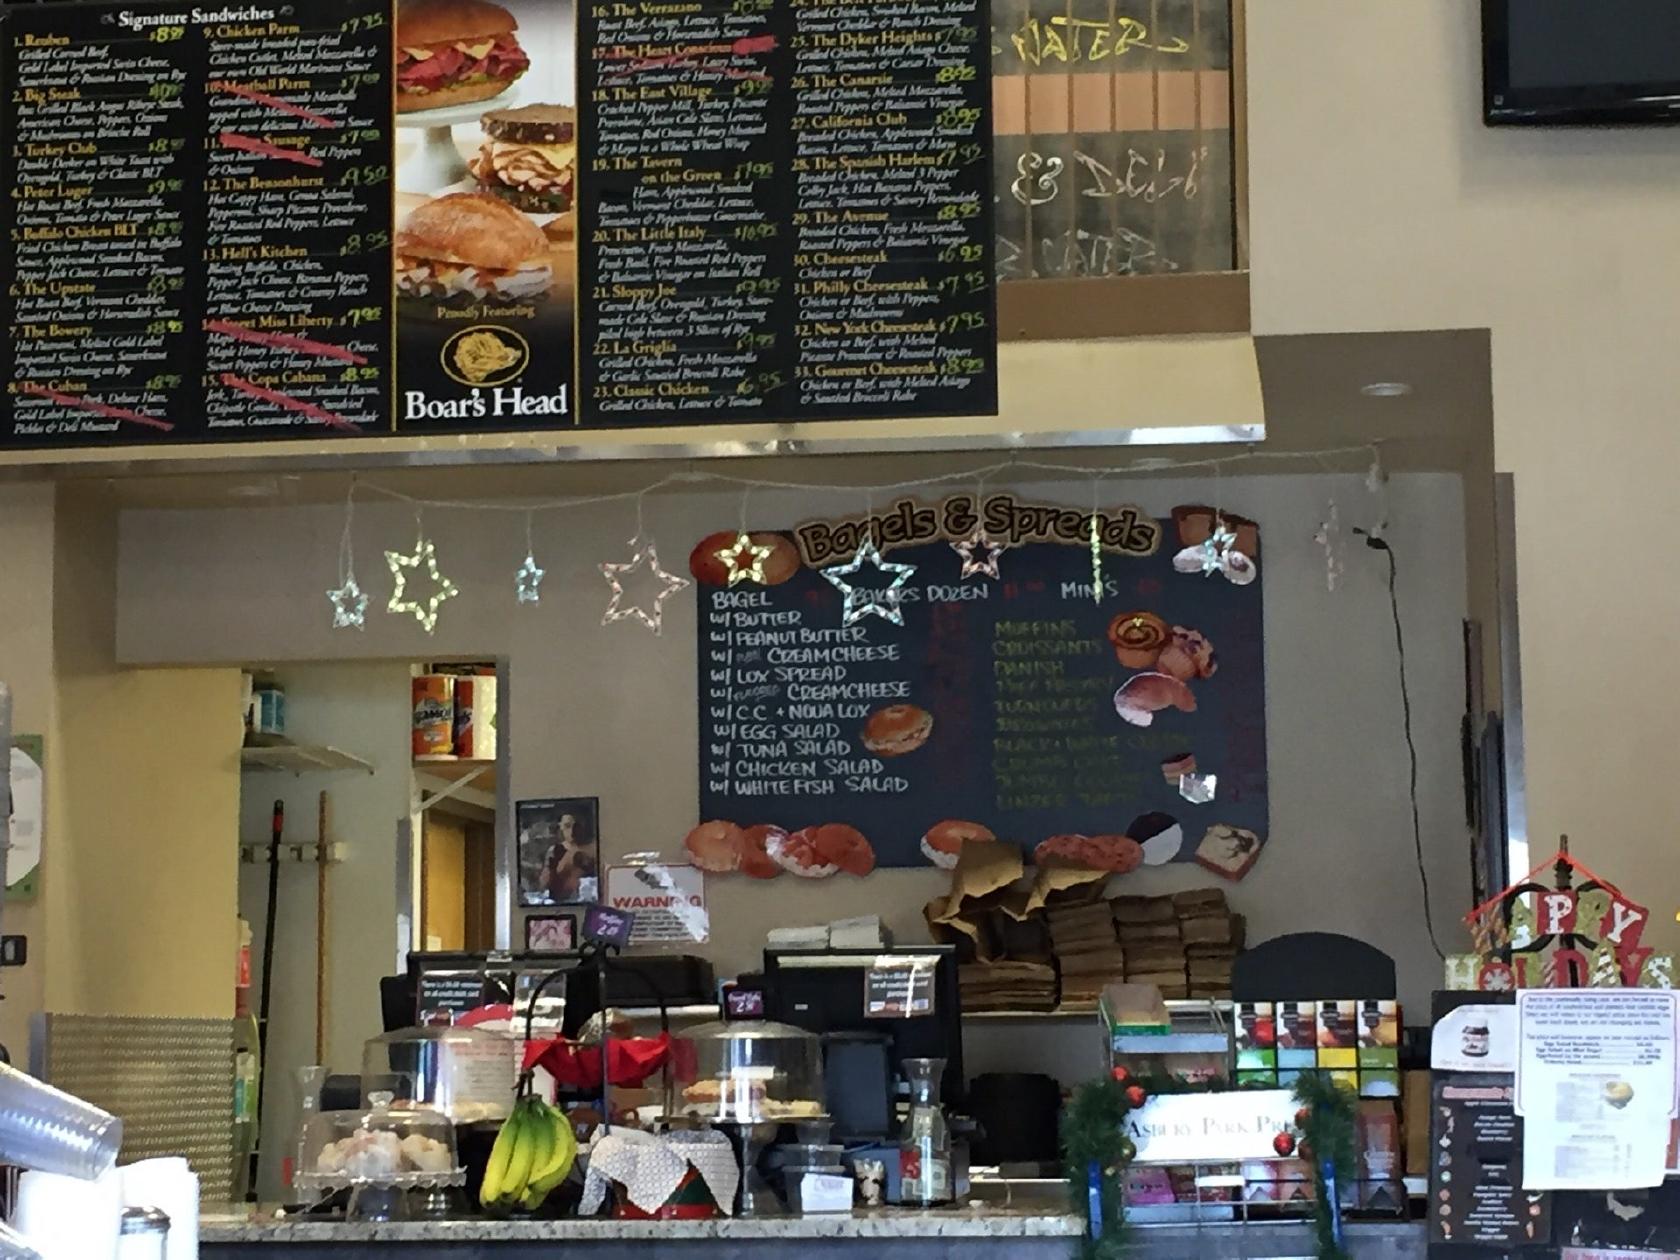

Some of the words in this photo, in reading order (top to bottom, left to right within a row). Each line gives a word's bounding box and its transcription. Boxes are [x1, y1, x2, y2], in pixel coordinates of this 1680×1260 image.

[612, 4, 636, 16] The
[118, 11, 188, 31] Signature
[191, 6, 274, 23] Sandwiches
[203, 28, 214, 39] 9.
[217, 25, 265, 38] Chicken
[269, 23, 300, 35] Parm
[25, 33, 70, 46] Reuben
[814, 34, 836, 46] The
[840, 32, 878, 48] Dyker
[882, 31, 932, 45] Heights
[279, 78, 311, 91] Parm
[813, 75, 836, 87] The
[839, 73, 893, 86] Canarsie
[25, 88, 46, 105] Big
[612, 88, 637, 99] The
[640, 86, 666, 98] East
[669, 84, 712, 101] Village
[812, 115, 873, 129] California
[876, 113, 907, 124] Club
[26, 143, 64, 156] Turkey
[68, 142, 97, 154] Club
[614, 157, 637, 170] The
[641, 156, 682, 167] Tavern
[815, 157, 837, 170] The
[840, 155, 886, 171] Spanish
[889, 153, 935, 166] Harlem
[223, 177, 247, 190] The
[250, 176, 324, 189] Bensonhurst
[642, 175, 657, 184] on
[660, 171, 680, 182] the
[683, 169, 722, 181] Green
[11, 188, 22, 198] 4.
[24, 186, 54, 197] Peter
[58, 184, 93, 199] Luger
[815, 211, 838, 223] The
[843, 210, 889, 222] Avenue
[24, 228, 63, 240] Buffalo
[66, 226, 112, 238] Chicken
[115, 223, 138, 236] BLT
[615, 229, 638, 241] The
[641, 227, 675, 239] Little
[678, 226, 706, 241] Italy
[261, 246, 308, 257] Kitchen
[814, 250, 888, 264] Cheesesteak
[24, 283, 47, 295] The
[51, 281, 96, 297] Upstate
[593, 286, 610, 298] 21.
[612, 284, 655, 300] Sloppy
[658, 283, 677, 299] Joe
[814, 281, 849, 298] Philly
[853, 277, 929, 292] Cheesesteak
[260, 315, 287, 327] Miss
[290, 314, 333, 328] Liberty
[815, 323, 840, 334] New
[842, 321, 869, 333] York
[871, 319, 936, 333] Cheesesteak
[23, 325, 47, 337] The
[50, 325, 92, 337] Bowery
[614, 342, 629, 353] La
[633, 340, 677, 356] Griglia
[282, 369, 326, 382] Cabana
[815, 364, 867, 376] Gourmet
[869, 361, 936, 375] Cheesesteak
[614, 384, 654, 396] Classic
[658, 383, 710, 394] Chicken
[405, 388, 486, 419] Boar's
[493, 382, 568, 416] Head
[800, 501, 936, 562] Bagels
[945, 497, 978, 536] &
[984, 496, 1156, 553] Spreads
[712, 591, 773, 610] BAGEL
[926, 583, 989, 603] DOZEN
[735, 611, 802, 627] BUTTER
[736, 630, 797, 646] PEANUT
[800, 627, 870, 643] BUTTER
[736, 669, 770, 684] LOX
[774, 665, 847, 682] SPREAD
[837, 703, 870, 718] LOX
[740, 724, 777, 740] EGG
[782, 722, 841, 739] SALAD
[736, 743, 788, 758] TUNA
[793, 740, 850, 756] SALAD
[735, 761, 817, 778] CHICKEN
[823, 758, 884, 777] SALAD
[844, 776, 908, 793] SALAD
[613, 895, 702, 908] WARNG
[1202, 1117, 1248, 1136] PARK
[1256, 1115, 1293, 1133] PRE
